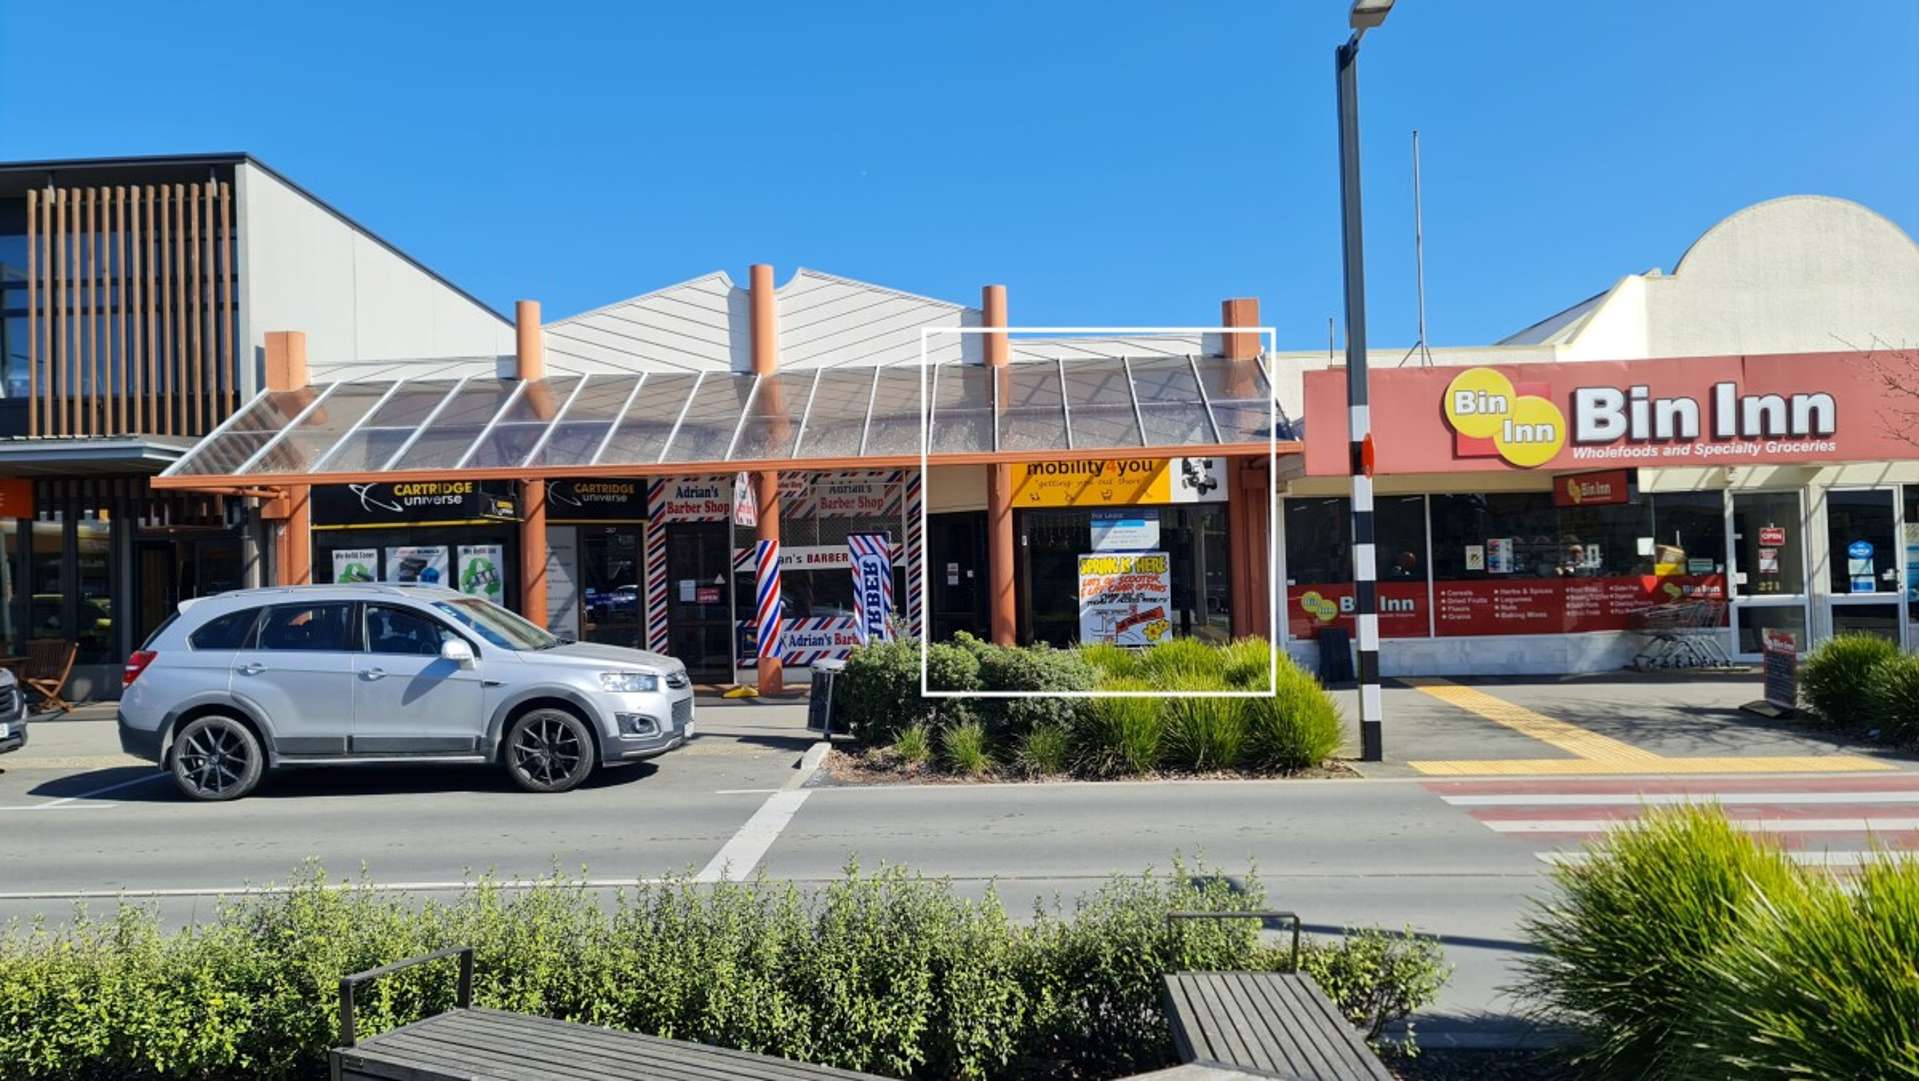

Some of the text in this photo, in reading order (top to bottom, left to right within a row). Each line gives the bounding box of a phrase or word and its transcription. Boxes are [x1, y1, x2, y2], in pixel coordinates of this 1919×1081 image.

[1454, 390, 1507, 415] Bin
[1576, 382, 1836, 443] Bin Inn
[1503, 418, 1555, 444] Inn
[1573, 440, 1837, 459] Wholefoods and Specialty Groceries
[394, 482, 473, 496] CARTRIDGE
[574, 483, 635, 494] CARTRIDGE
[676, 484, 719, 498] Adrian's
[404, 495, 464, 506] universe
[582, 494, 628, 502] universe
[820, 495, 884, 511] Barber Shop
[667, 500, 730, 515] Barber Shop
[1760, 532, 1782, 540] OPEN
[807, 552, 849, 564] BARBER
[1135, 555, 1168, 574] HERE
[1380, 595, 1415, 611] Inn
[789, 632, 861, 647] Adrian's Barb
